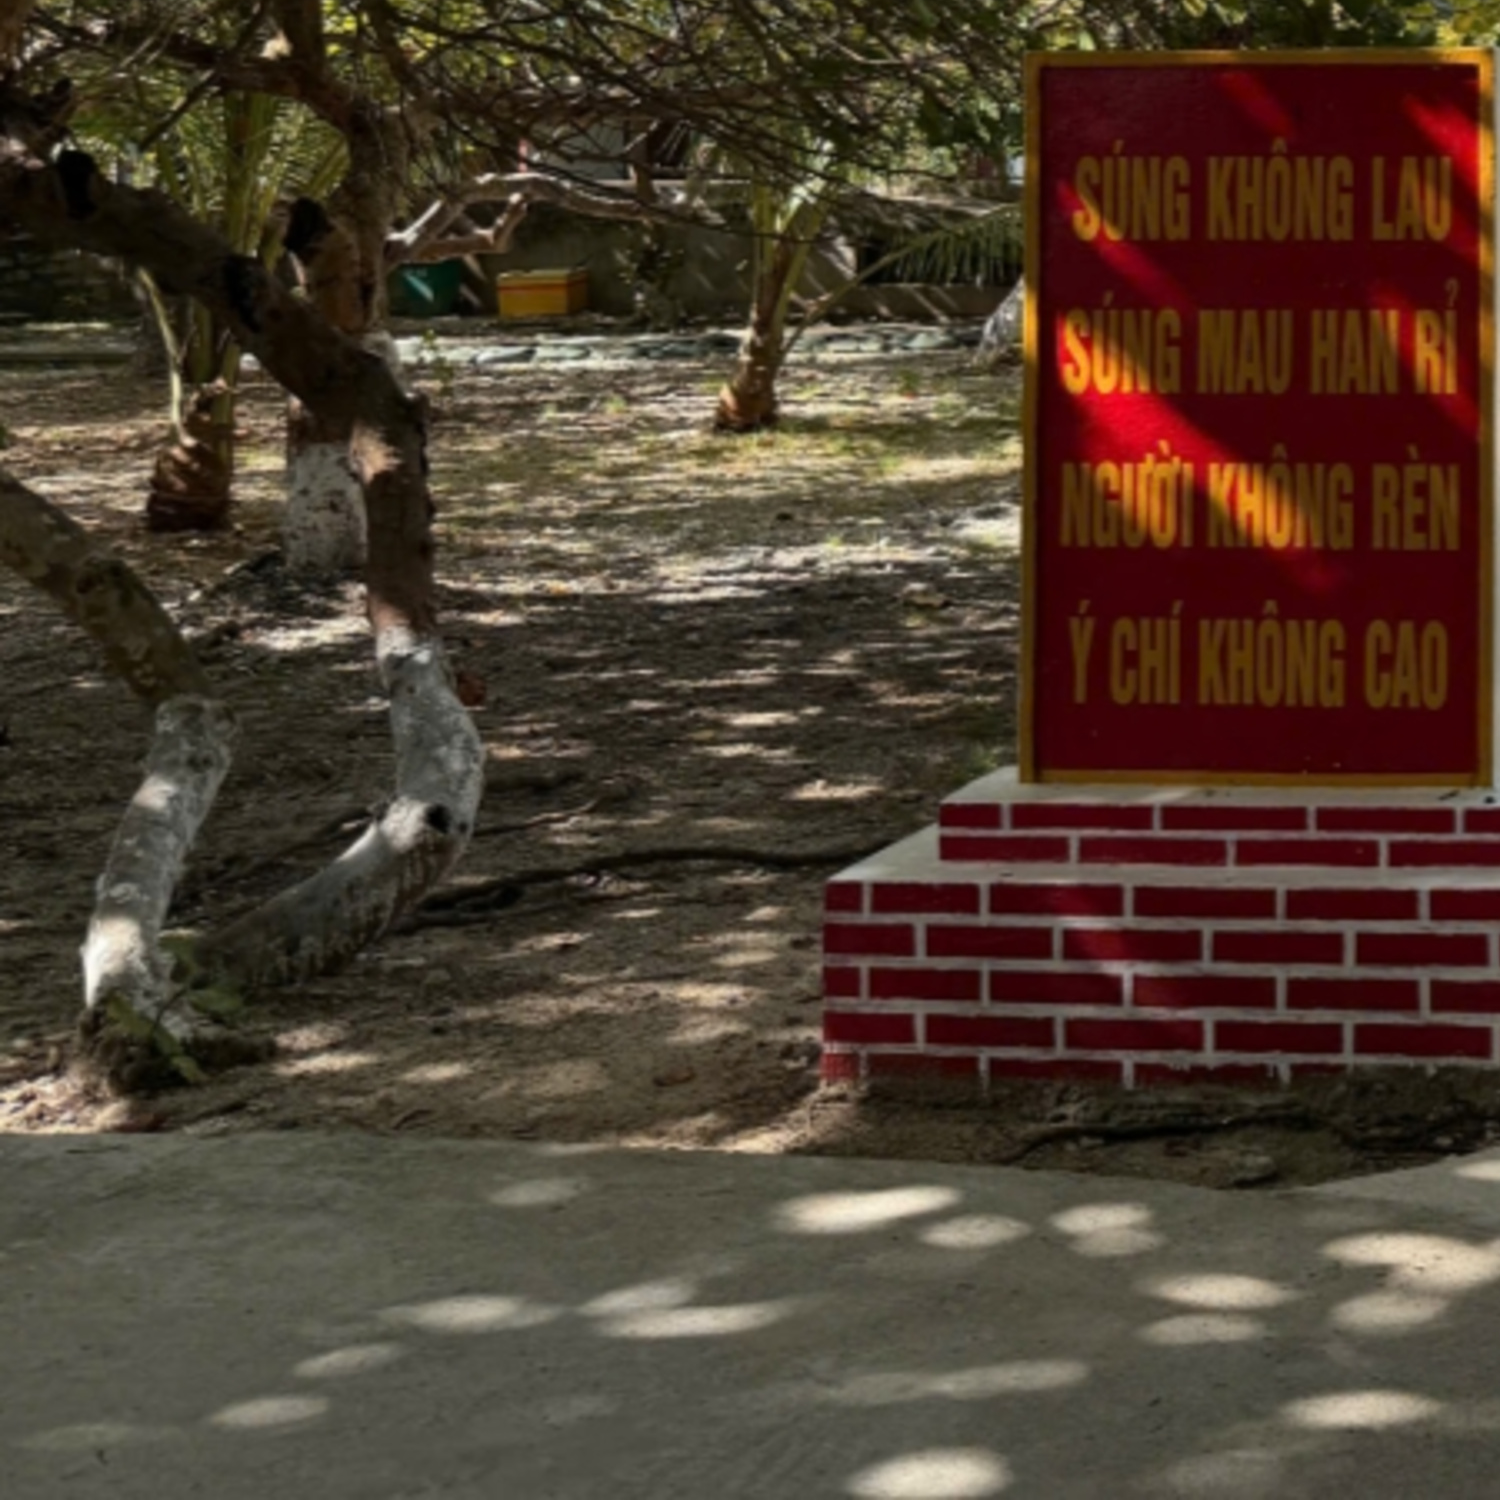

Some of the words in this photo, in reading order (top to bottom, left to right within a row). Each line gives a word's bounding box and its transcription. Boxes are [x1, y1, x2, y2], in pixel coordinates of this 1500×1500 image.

[1072, 139, 1190, 241] SÚNG
[1208, 137, 1354, 241] KHÔNG
[1371, 155, 1453, 241] LAU
[1062, 291, 1182, 395] SÚNG
[1199, 308, 1294, 395] MAU
[1311, 309, 1399, 395] HAN
[1413, 278, 1459, 395] RỈ
[1060, 439, 1194, 548] NGƯỜI
[1207, 443, 1354, 549] KHÔNG
[1371, 445, 1460, 550] RÈN
[1069, 599, 1094, 704] Ý
[1110, 600, 1183, 704] CHÍ
[1198, 600, 1346, 707] KHÔNG
[1364, 620, 1449, 710] CAO
